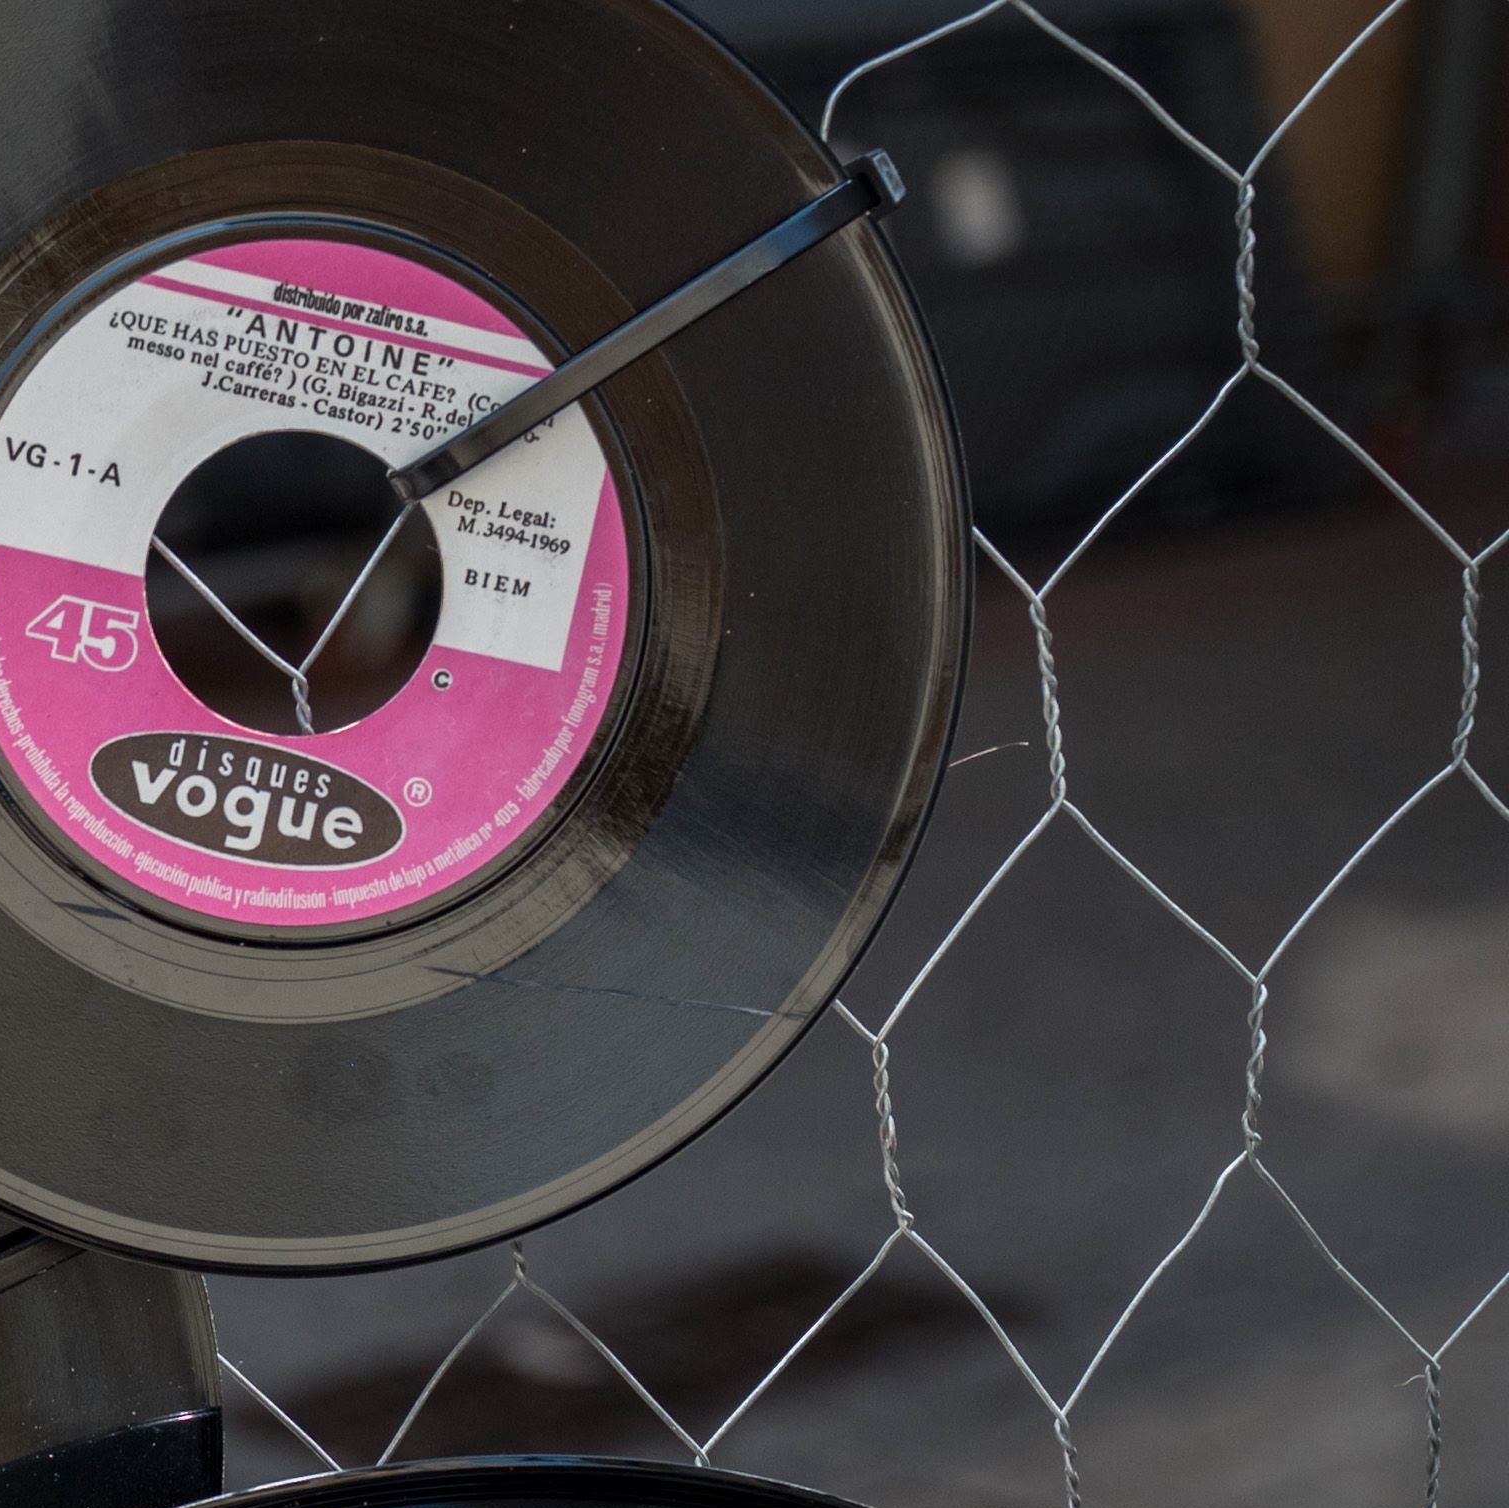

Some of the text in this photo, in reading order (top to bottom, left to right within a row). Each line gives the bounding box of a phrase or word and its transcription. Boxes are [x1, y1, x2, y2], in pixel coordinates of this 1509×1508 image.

[225, 306, 455, 378] "ANTOINE"
[272, 281, 430, 339] distribuido por zafiro s.a.
[107, 309, 458, 405] ¿QUE HAS PUESTO EN EL CAFE?
[125, 334, 187, 363] messo
[188, 350, 221, 370] nel
[335, 381, 407, 415] Bigazzi
[199, 369, 298, 410] J.Carreras
[311, 396, 385, 433] Castor)
[446, 486, 551, 530] Dep. Legal:
[463, 567, 533, 599] BIEM
[24, 592, 142, 675] 45
[167, 737, 332, 799] disques
[131, 758, 366, 853] vogue
